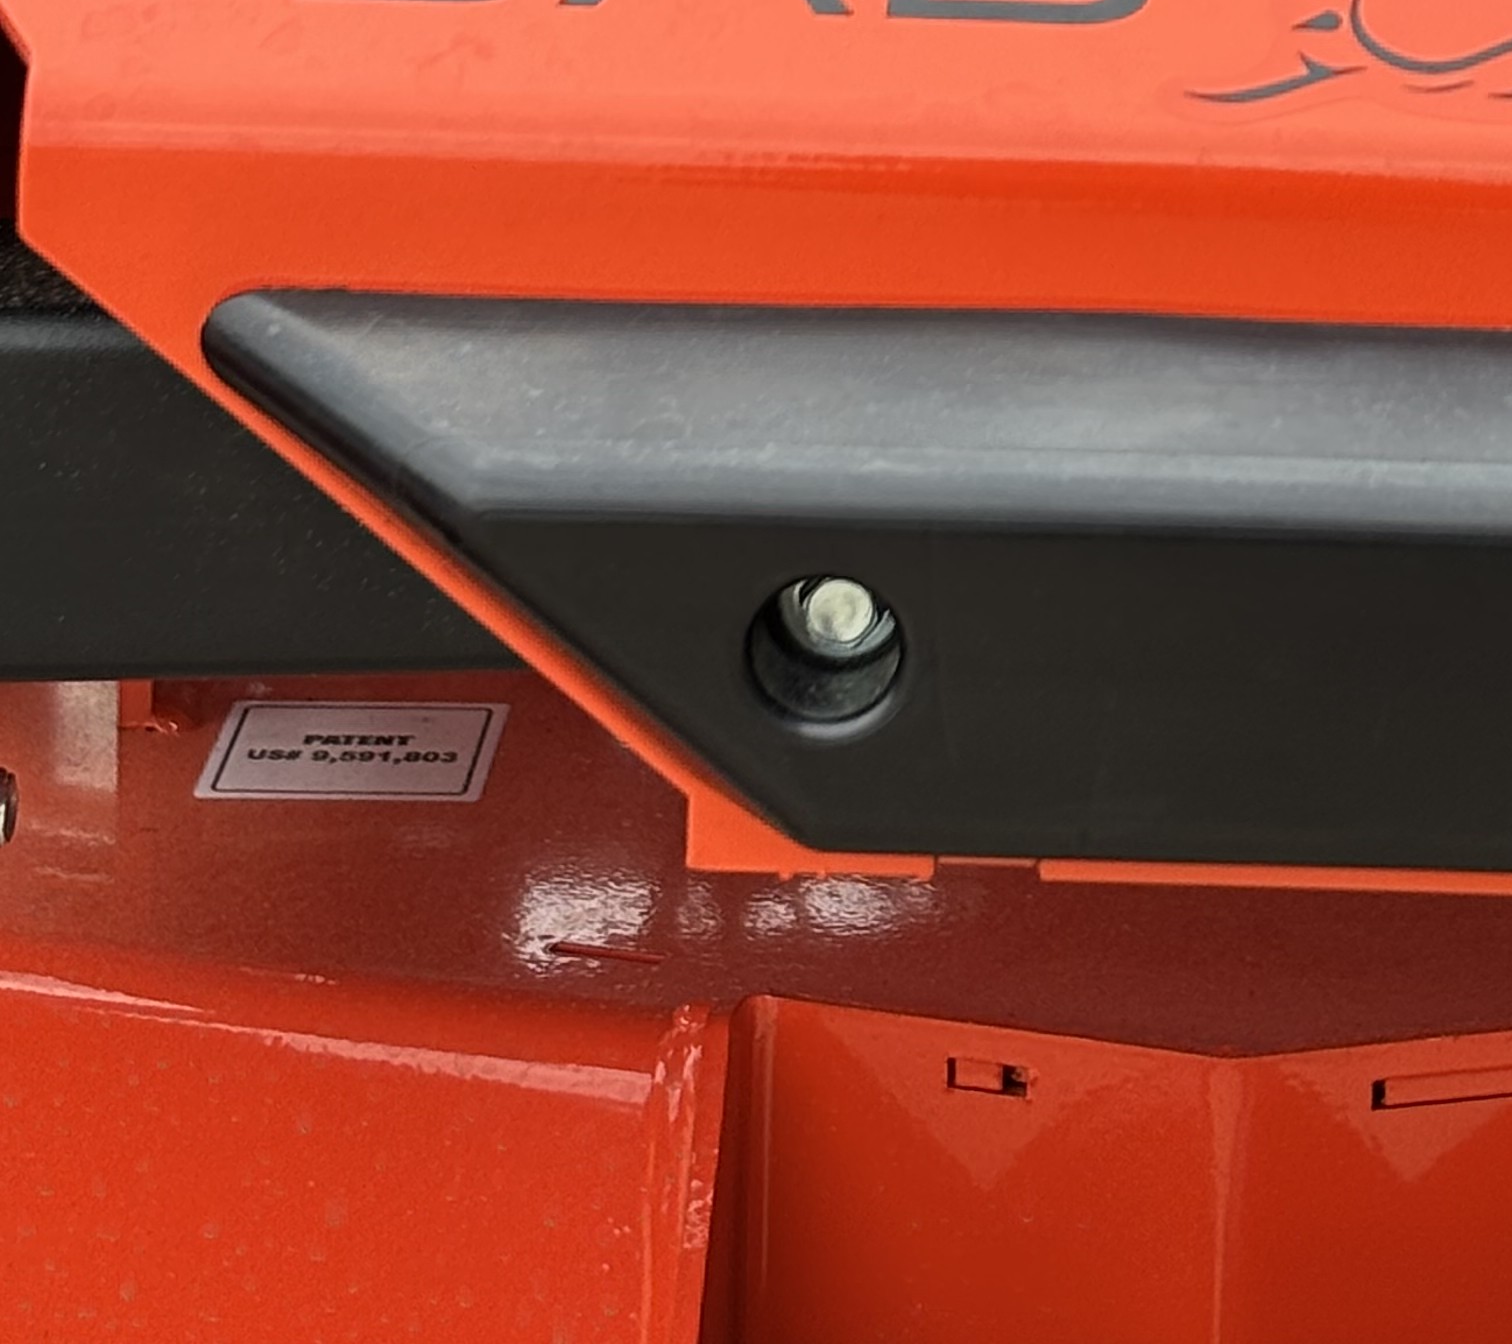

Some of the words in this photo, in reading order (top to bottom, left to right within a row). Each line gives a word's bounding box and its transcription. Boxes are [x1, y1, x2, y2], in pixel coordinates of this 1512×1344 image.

[303, 734, 416, 747] PATENT
[247, 748, 303, 761] US#
[311, 750, 458, 764] 9,591,803
